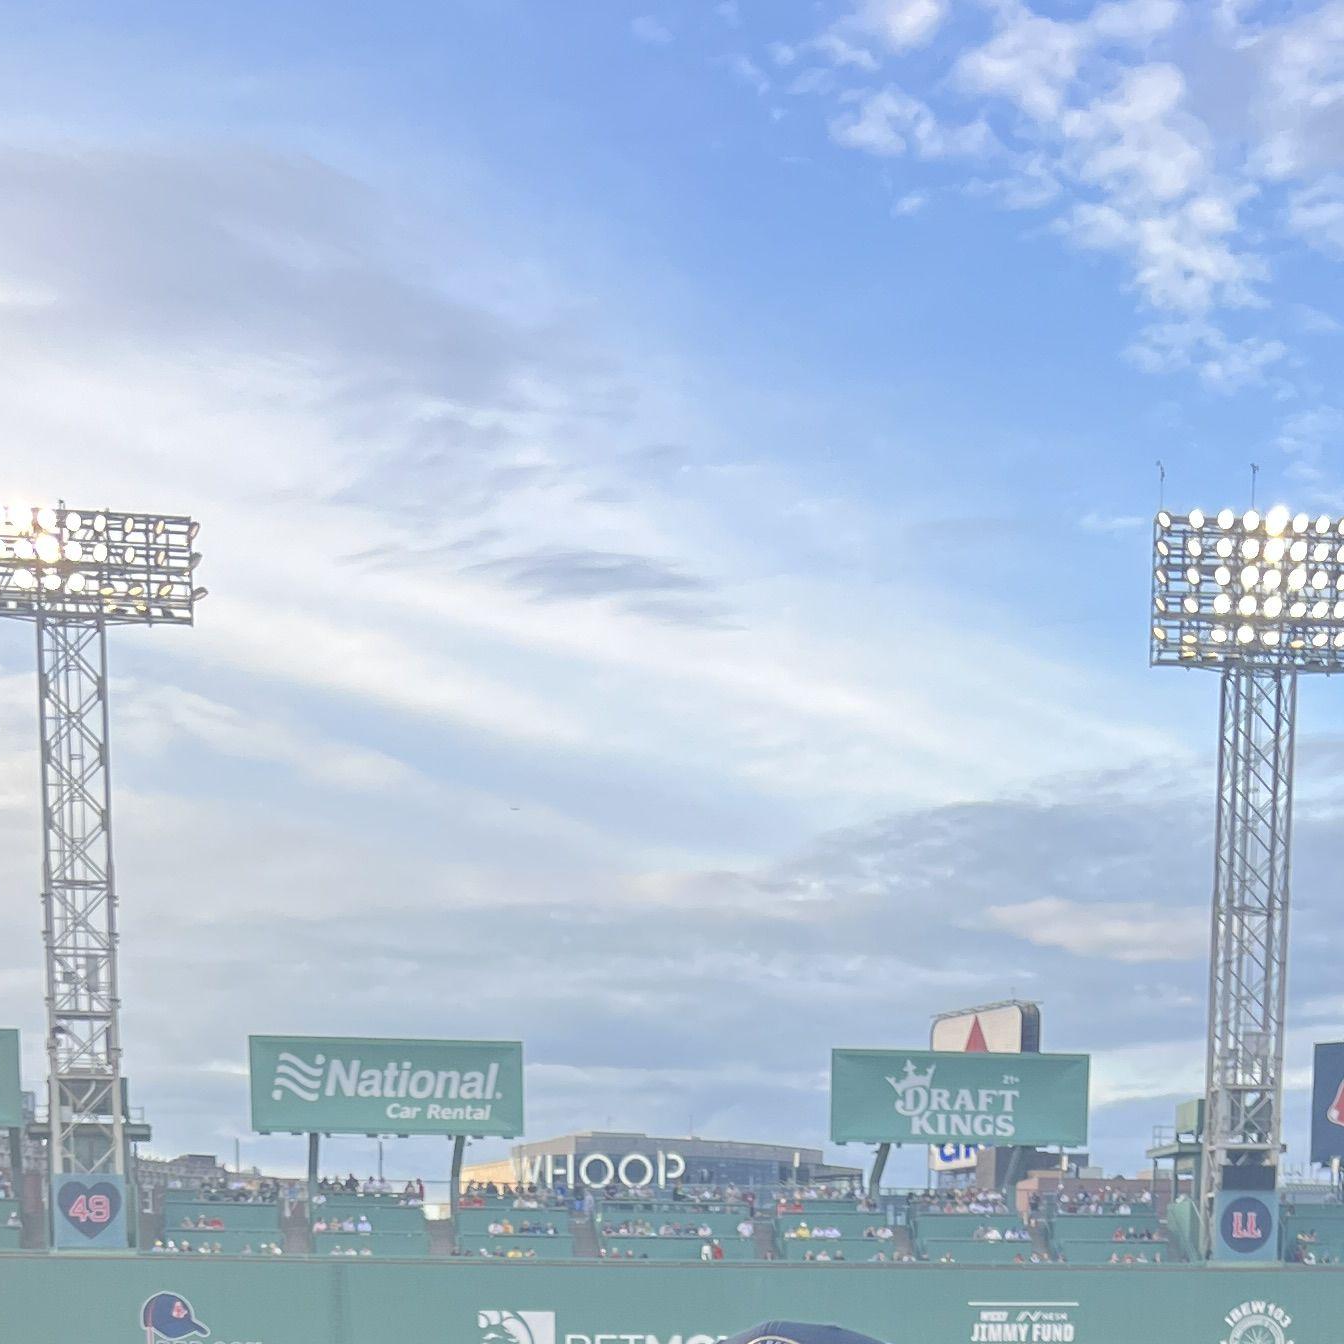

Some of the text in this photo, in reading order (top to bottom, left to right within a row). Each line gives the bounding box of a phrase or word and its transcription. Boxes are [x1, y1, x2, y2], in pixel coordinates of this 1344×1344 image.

[386, 1103, 492, 1121] Car Rental
[894, 1086, 1020, 1116] DRAFT
[910, 1111, 1016, 1137] KINGS
[513, 1150, 686, 1190] WHOOP
[68, 1195, 111, 1223] 49
[1224, 1301, 1292, 1328] IBEW 103
[970, 1323, 1075, 1342] JIMMY FUND
